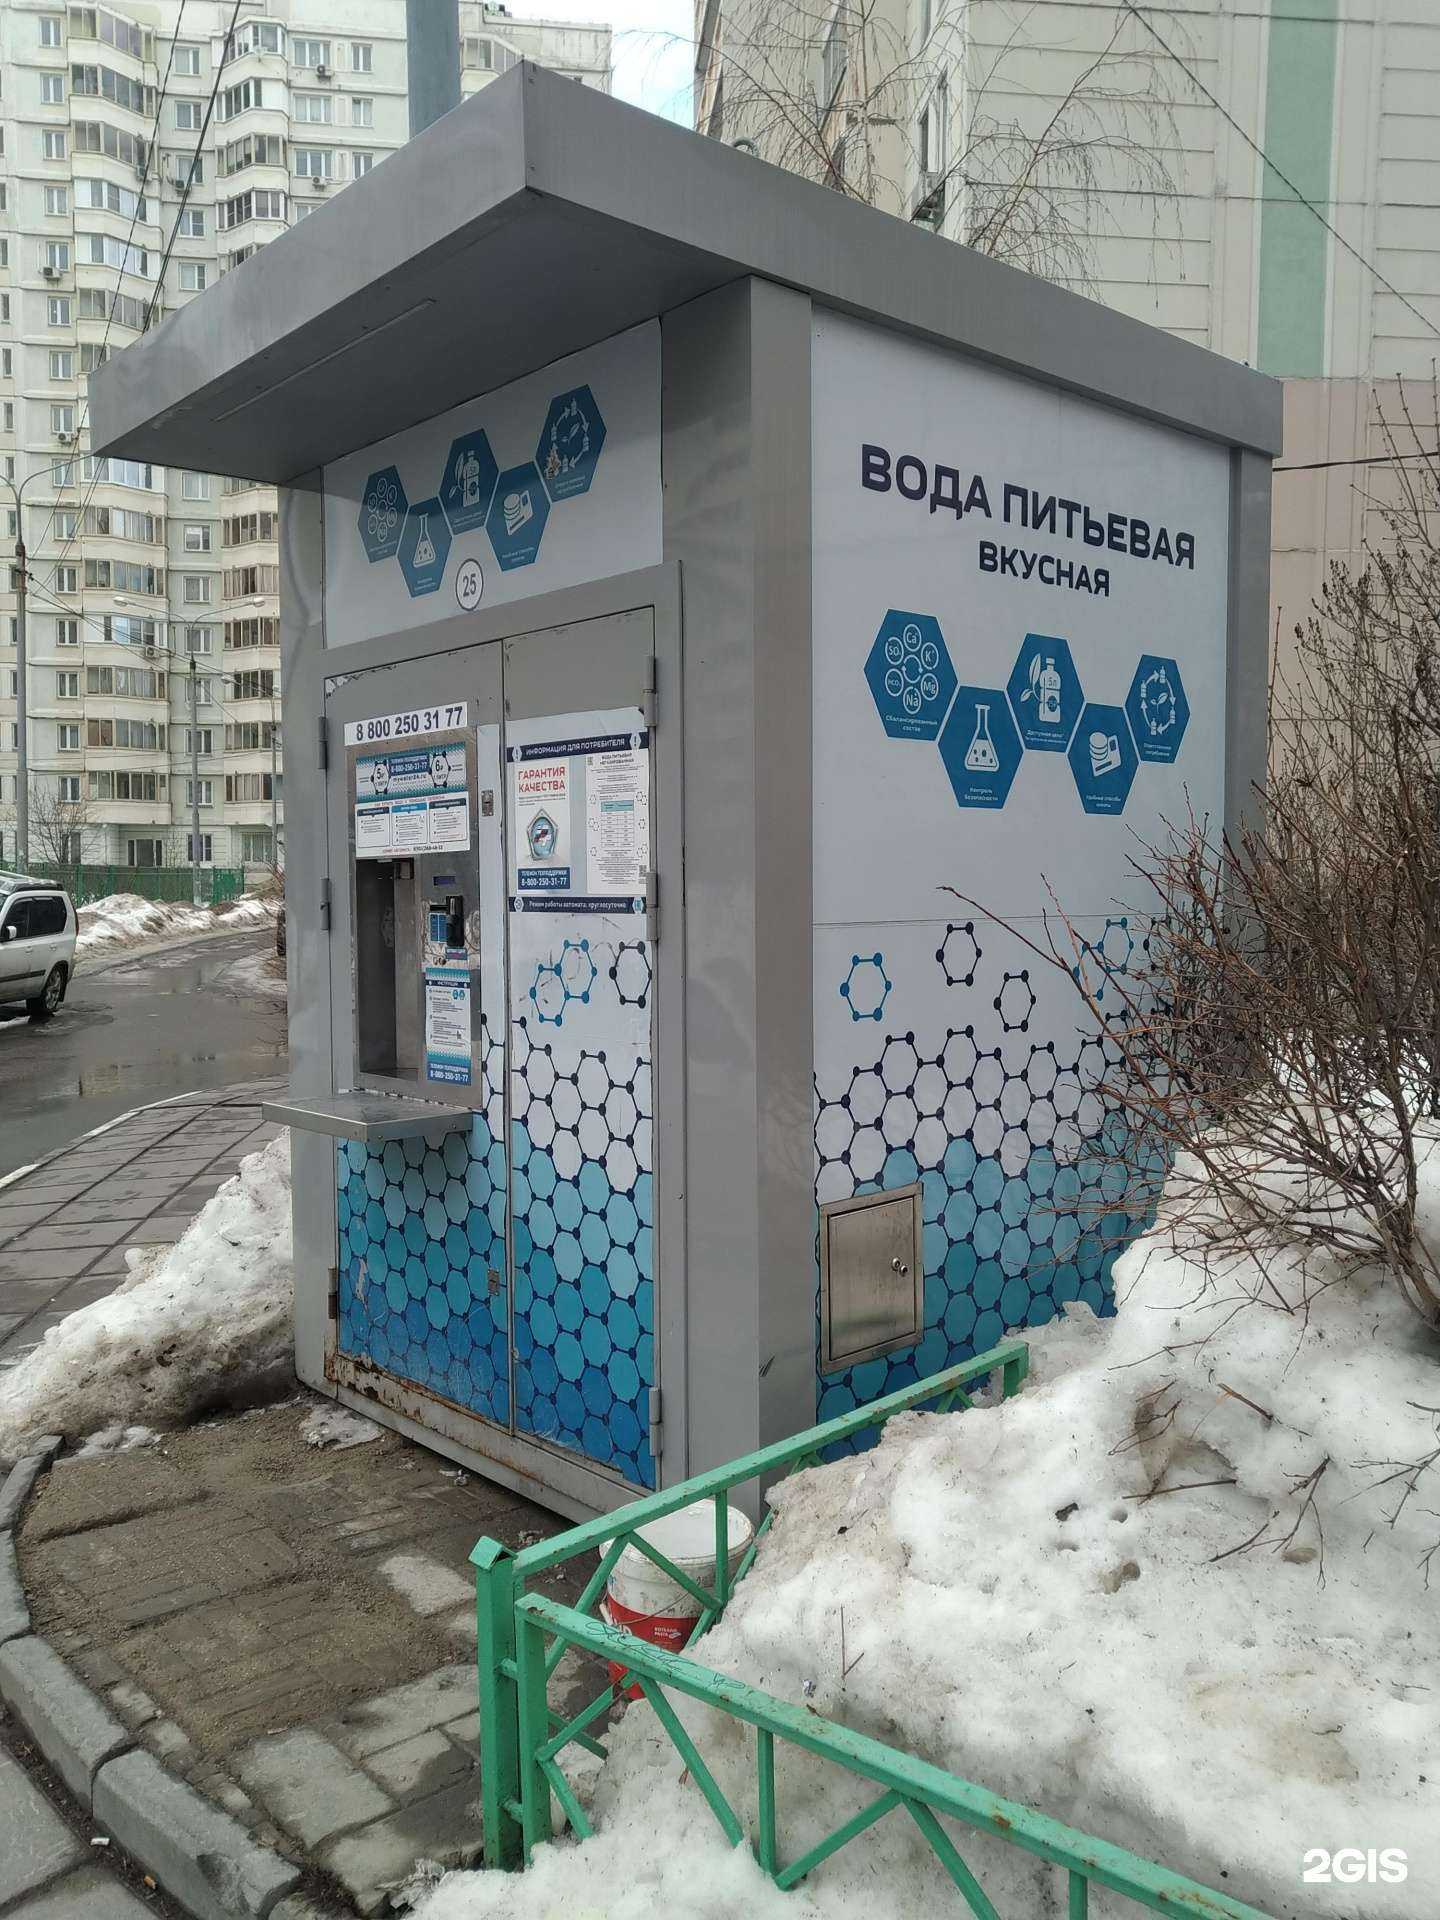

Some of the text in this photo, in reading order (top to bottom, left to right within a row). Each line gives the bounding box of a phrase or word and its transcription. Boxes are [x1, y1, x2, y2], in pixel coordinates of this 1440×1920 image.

[862, 443, 1195, 570] ВОДА ПИТЬЕВАЯ
[979, 540, 1110, 598] ВКУСНАЯ
[462, 573, 477, 597] 25
[356, 705, 463, 741] 8 800 250 31 77
[580, 738, 625, 750] ПОТРЕБИТЕЛЯ
[518, 766, 566, 781] ГАРАНТИЯ
[518, 780, 566, 793] КАЧЕСТВА
